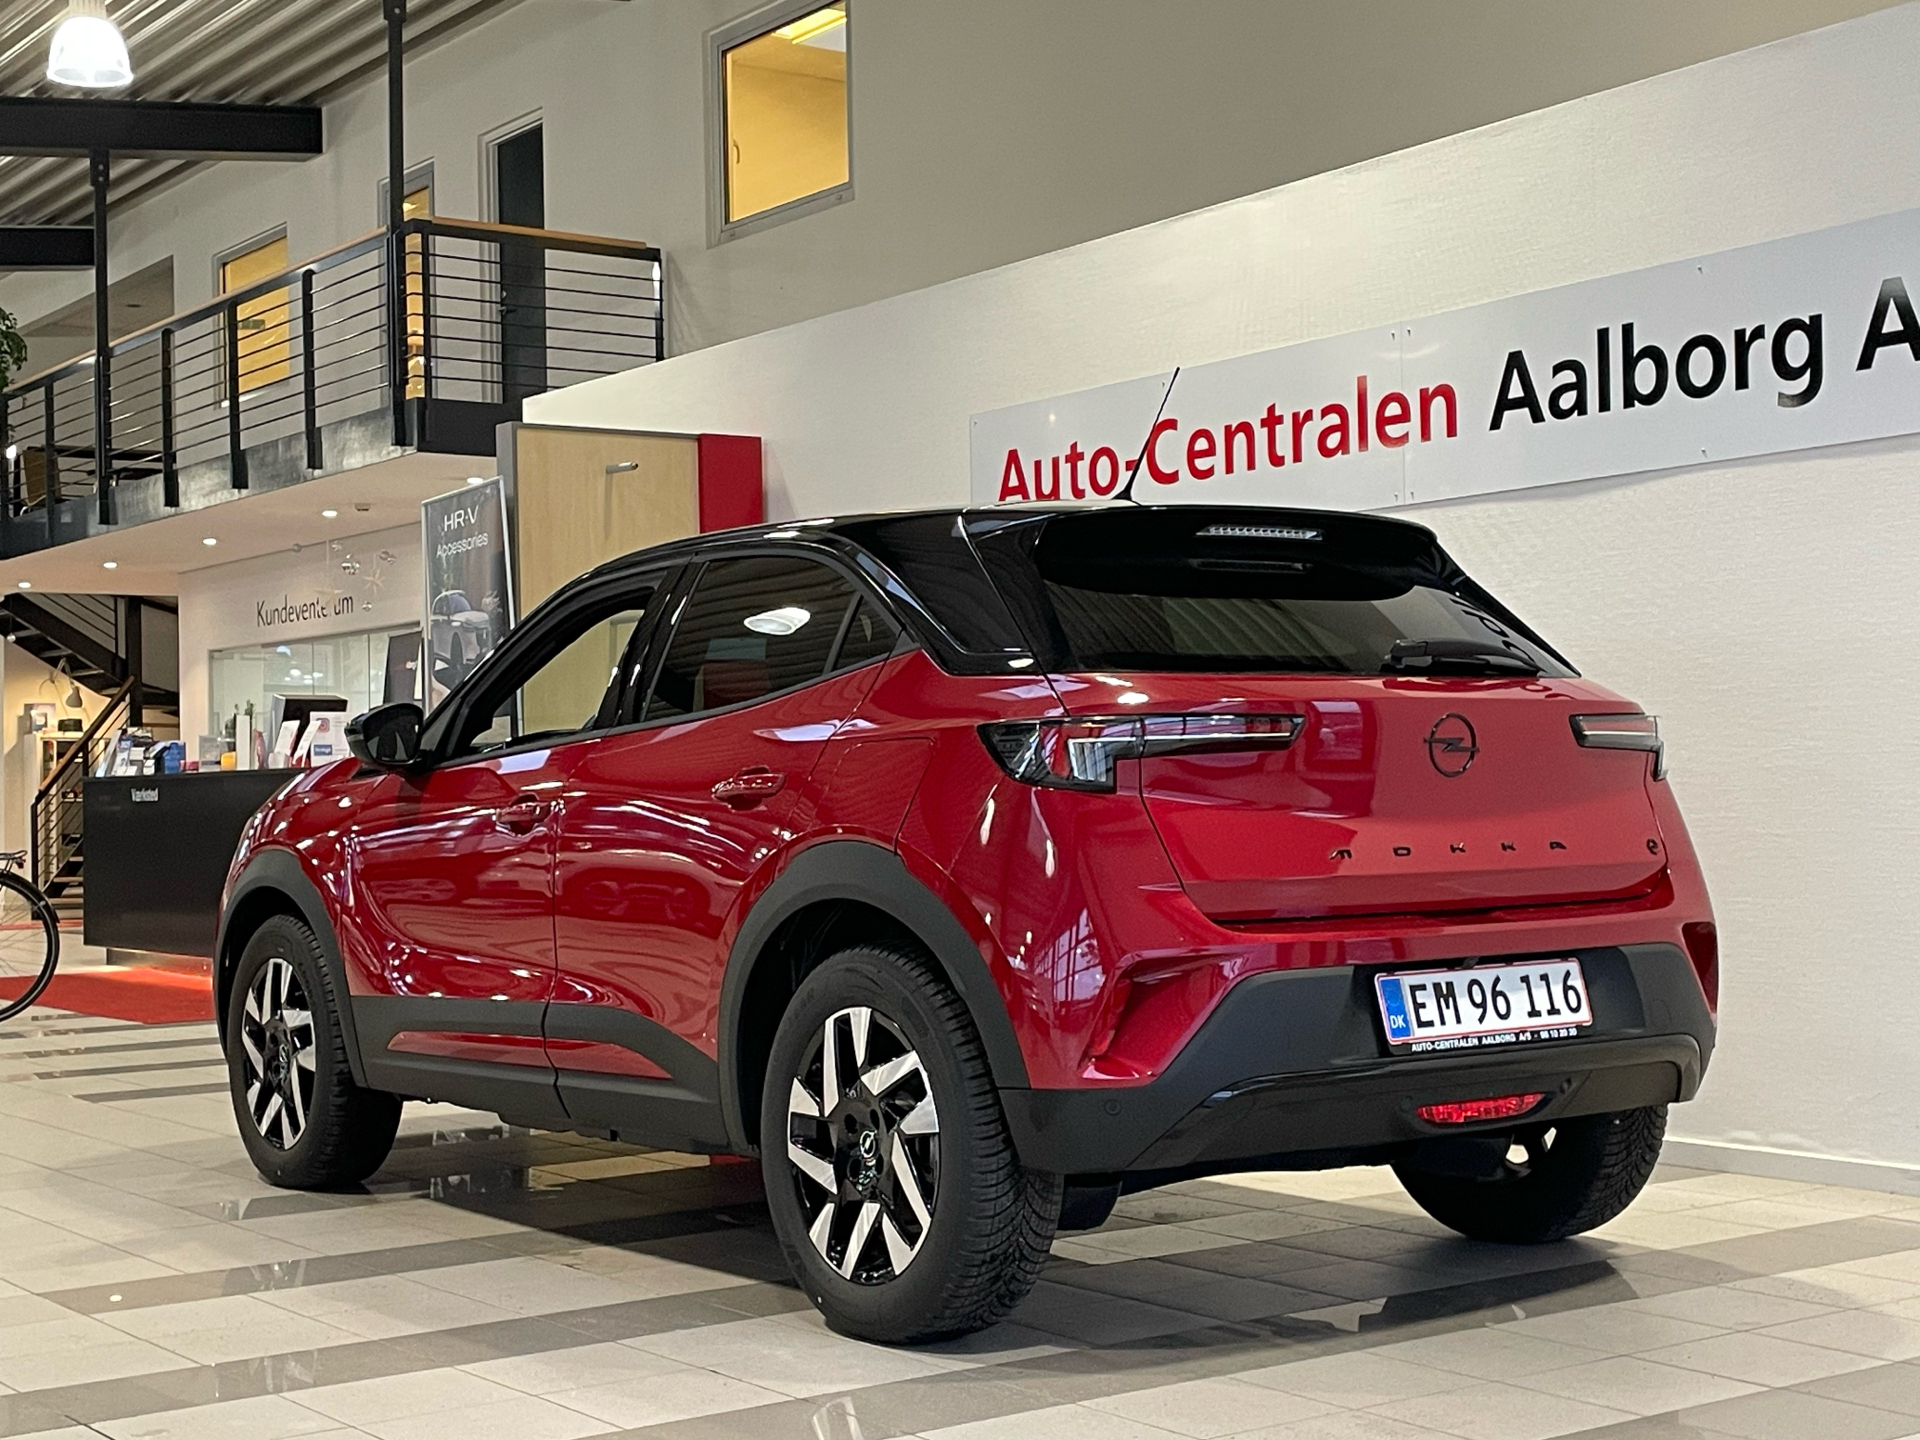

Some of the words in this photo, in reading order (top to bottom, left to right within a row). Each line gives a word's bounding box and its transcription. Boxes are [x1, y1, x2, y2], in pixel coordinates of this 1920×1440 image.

[998, 376, 1458, 501] Auto-Centralen
[1489, 313, 1823, 431] Aalborg
[436, 532, 489, 559] Accessories
[1409, 981, 1462, 1028] EM
[1467, 975, 1512, 1025] 96
[1520, 969, 1582, 1018] 116
[1390, 1014, 1406, 1029] DK
[1411, 1036, 1479, 1052] AUTO-CENTRALEN
[1481, 1032, 1516, 1045] AALBORG
[1518, 1030, 1532, 1041] A/S
